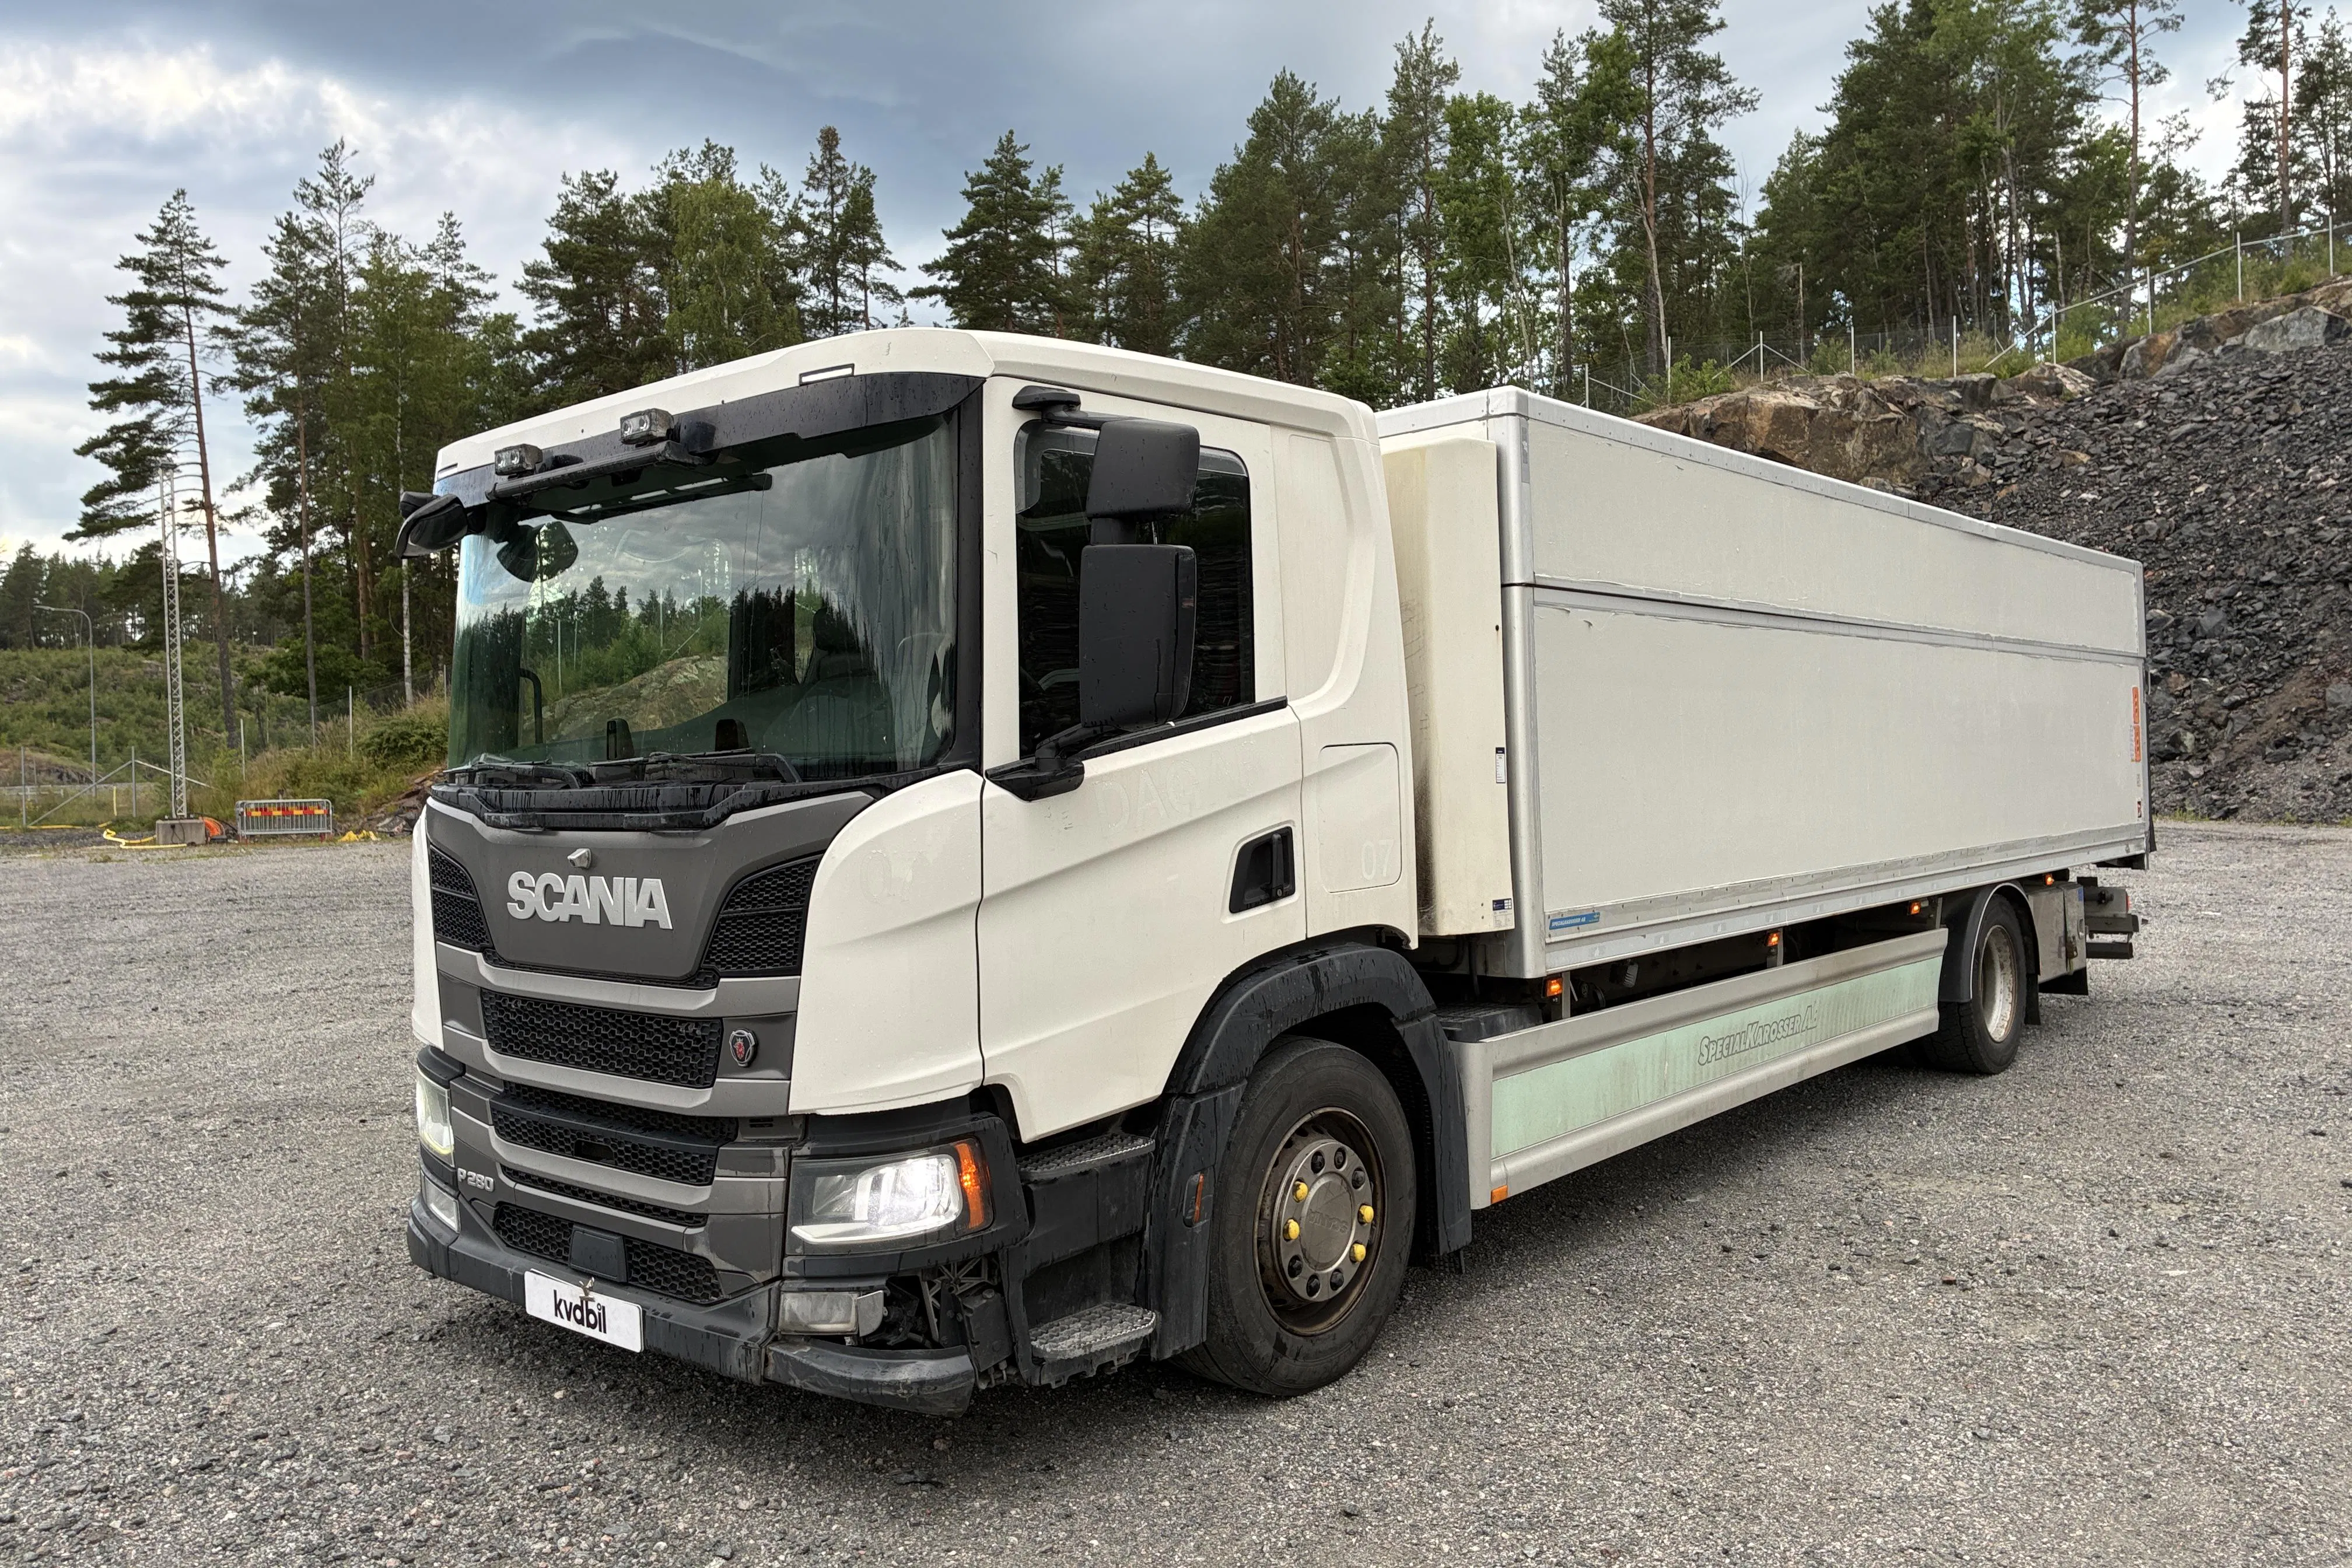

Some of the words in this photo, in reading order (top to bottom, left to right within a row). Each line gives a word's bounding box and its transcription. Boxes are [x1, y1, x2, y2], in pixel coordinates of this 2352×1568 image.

[1361, 839, 1395, 880] 07
[507, 871, 673, 930] SCANIA
[554, 1289, 607, 1334] kvdbil
